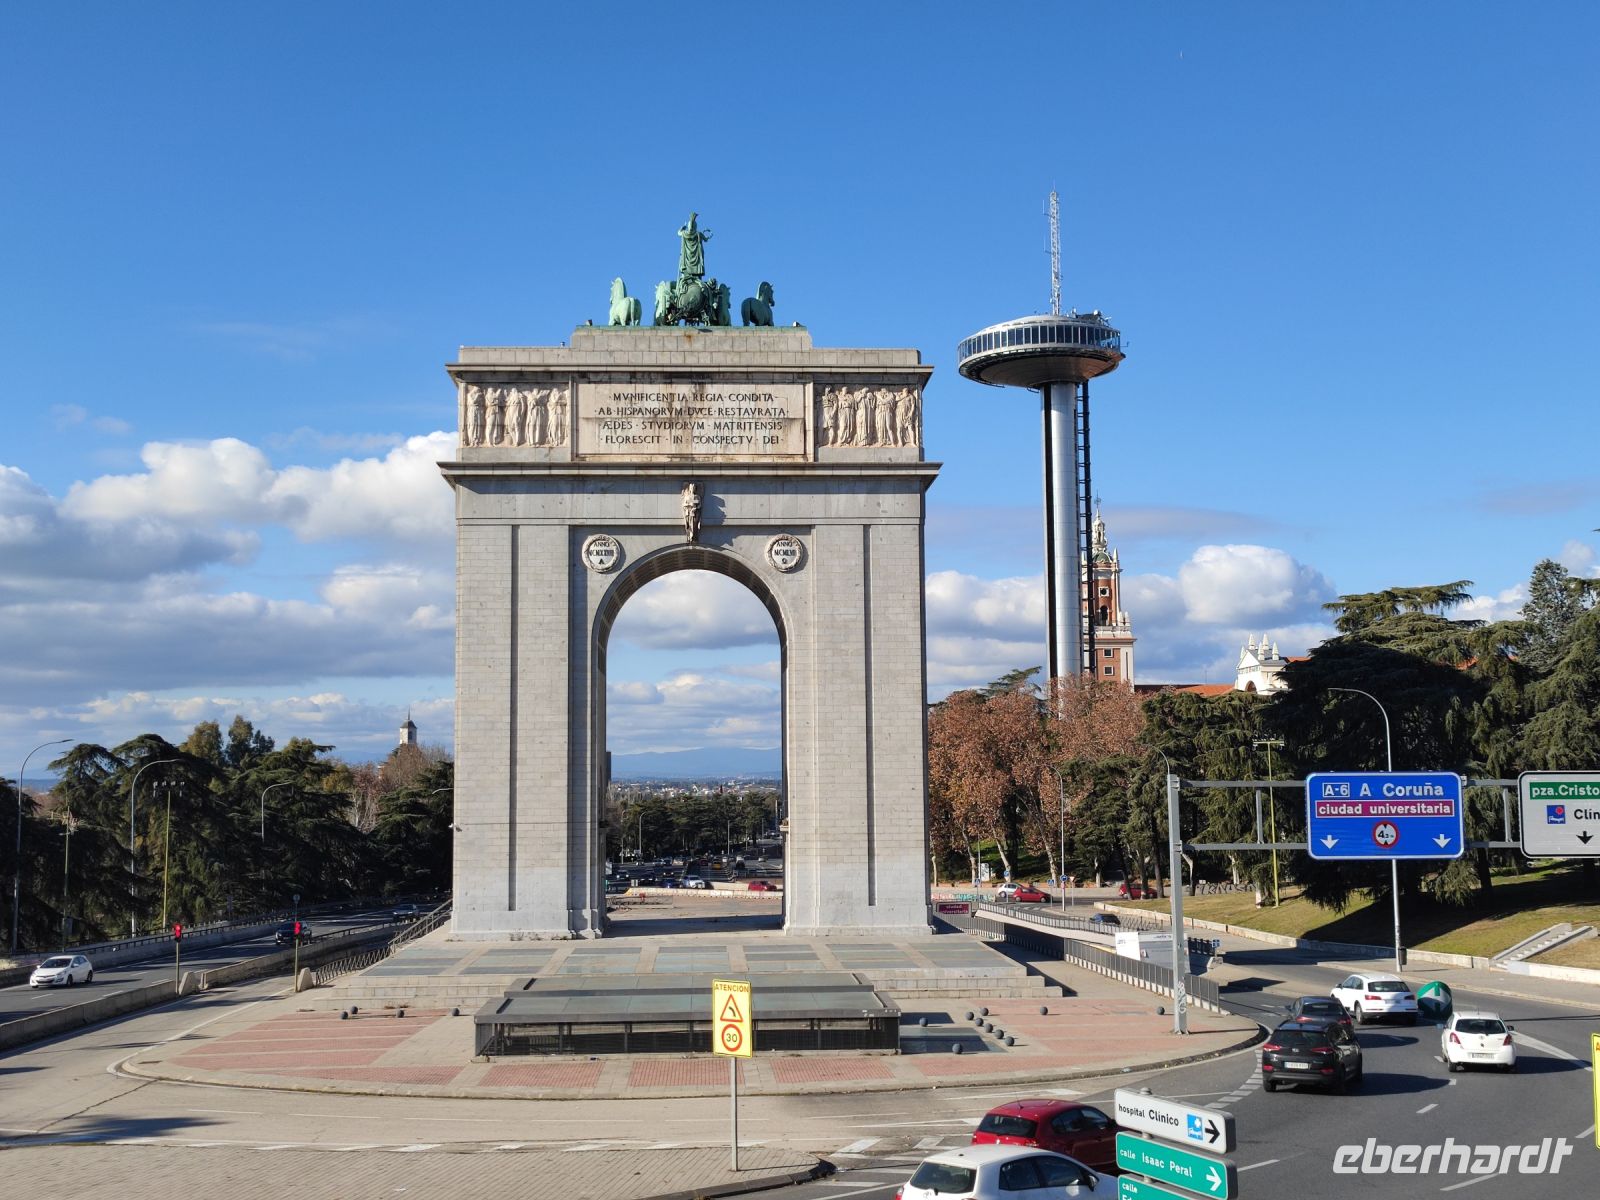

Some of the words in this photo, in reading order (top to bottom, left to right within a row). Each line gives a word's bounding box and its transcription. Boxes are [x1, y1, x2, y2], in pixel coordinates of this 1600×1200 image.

[713, 421, 783, 430] MATRITENSIS
[605, 435, 661, 444] FLORESCIT
[692, 435, 753, 445] CONSPECTV
[1324, 784, 1348, 796] A-6
[1359, 783, 1372, 797] A
[1382, 783, 1444, 797] Coruña
[1318, 803, 1362, 815] ciudad
[1369, 802, 1451, 815] universitaria
[726, 1033, 738, 1042] 30
[1118, 1103, 1145, 1118] hospital
[1119, 1148, 1136, 1160] calle
[1142, 1152, 1165, 1169] Isaac
[1169, 1160, 1193, 1178] Peral
[1122, 1182, 1138, 1194] calle
